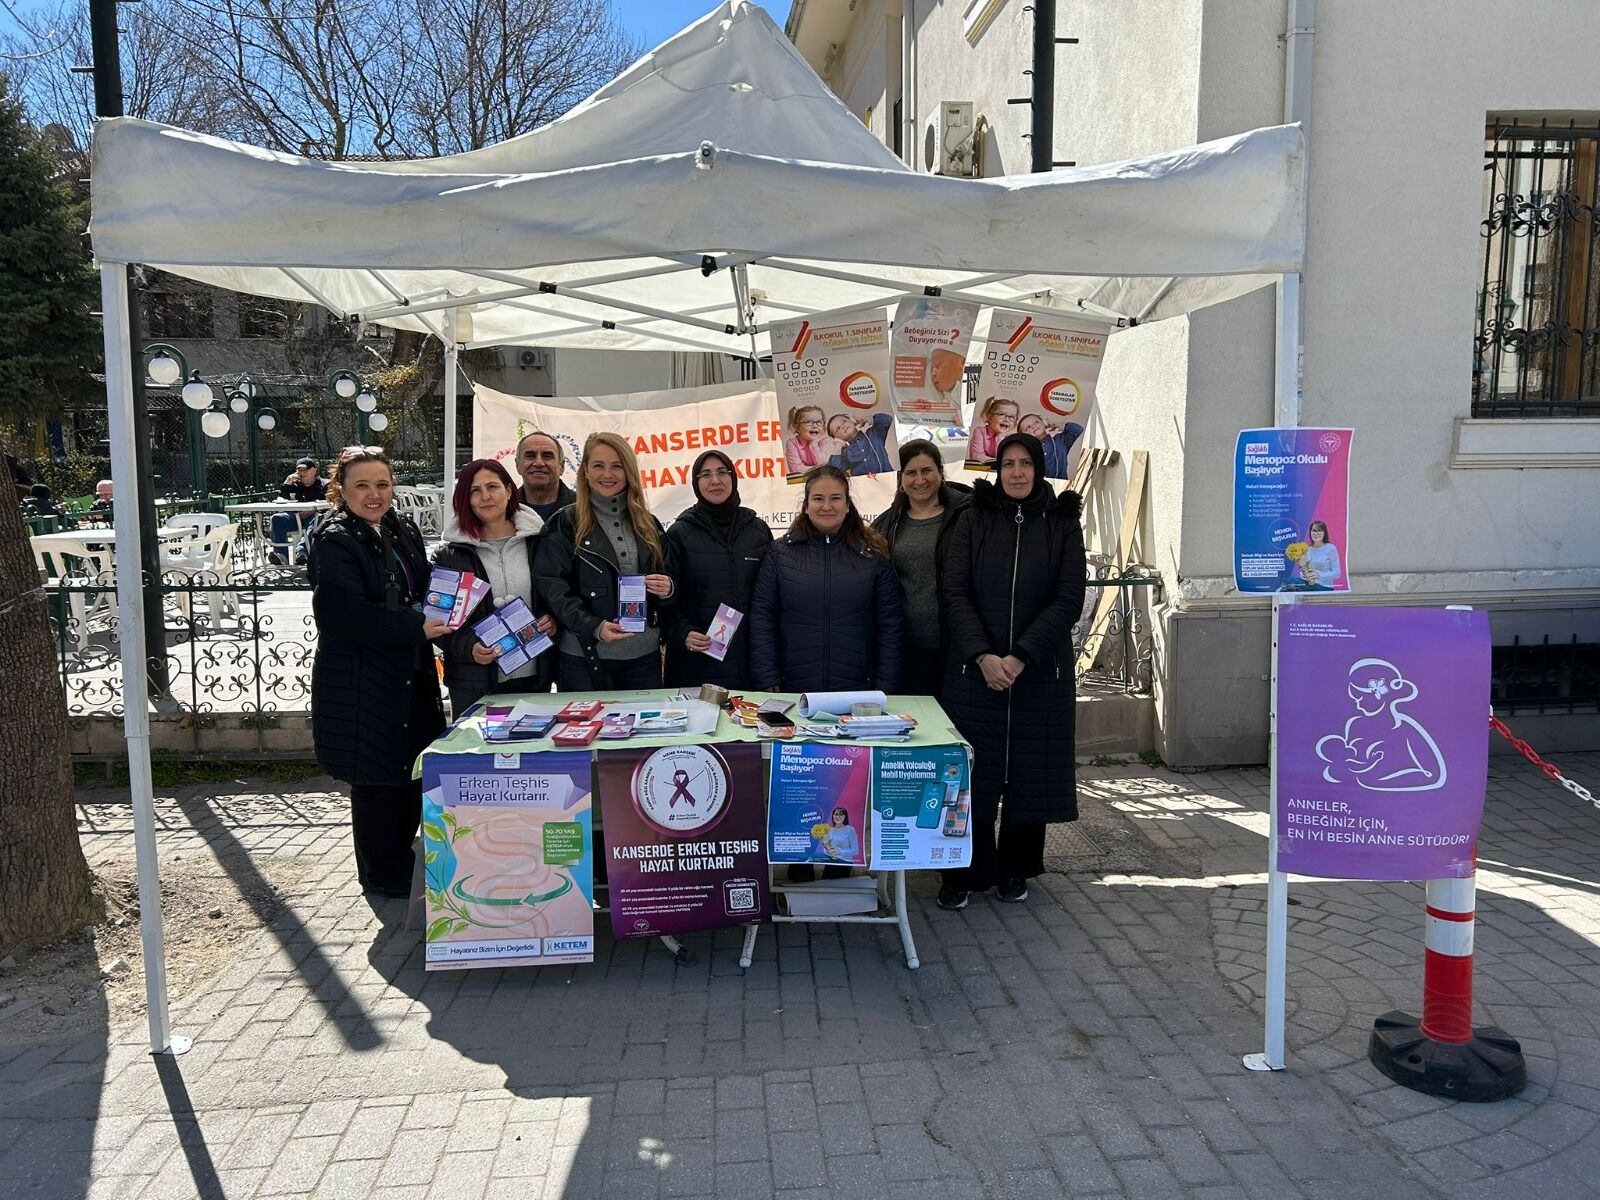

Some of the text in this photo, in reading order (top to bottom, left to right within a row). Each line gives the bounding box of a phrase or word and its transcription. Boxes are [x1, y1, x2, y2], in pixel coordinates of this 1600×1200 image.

[904, 327, 936, 336] Bebeğiniz
[908, 336, 936, 344] Duyuyor
[624, 422, 750, 456] ANSERDE
[1244, 454, 1328, 466] Menopoz Okulu
[1244, 465, 1284, 477] Başlıyor!
[780, 755, 852, 766] Menopoz Okulu
[881, 760, 936, 770] Annelik Yolculuğu
[780, 764, 814, 773] Başlıyor!
[881, 771, 936, 780] Mobil Uygulaması
[459, 776, 550, 791] Erken Teşhis
[459, 791, 550, 804] Hayat Kurtarır.
[1288, 798, 1352, 814] ANNELER,
[1288, 812, 1388, 832] BEBEĞİNİZ İÇİN,
[1287, 828, 1470, 846] EN İYİ BESİN ANNE SÜTÜDÜR!
[613, 844, 674, 859] KANSERDE
[678, 842, 716, 856] ERKEN
[719, 840, 759, 854] TEŞHİS
[640, 856, 734, 872] HAYAT KURTARIR
[554, 941, 587, 950] KETEM
